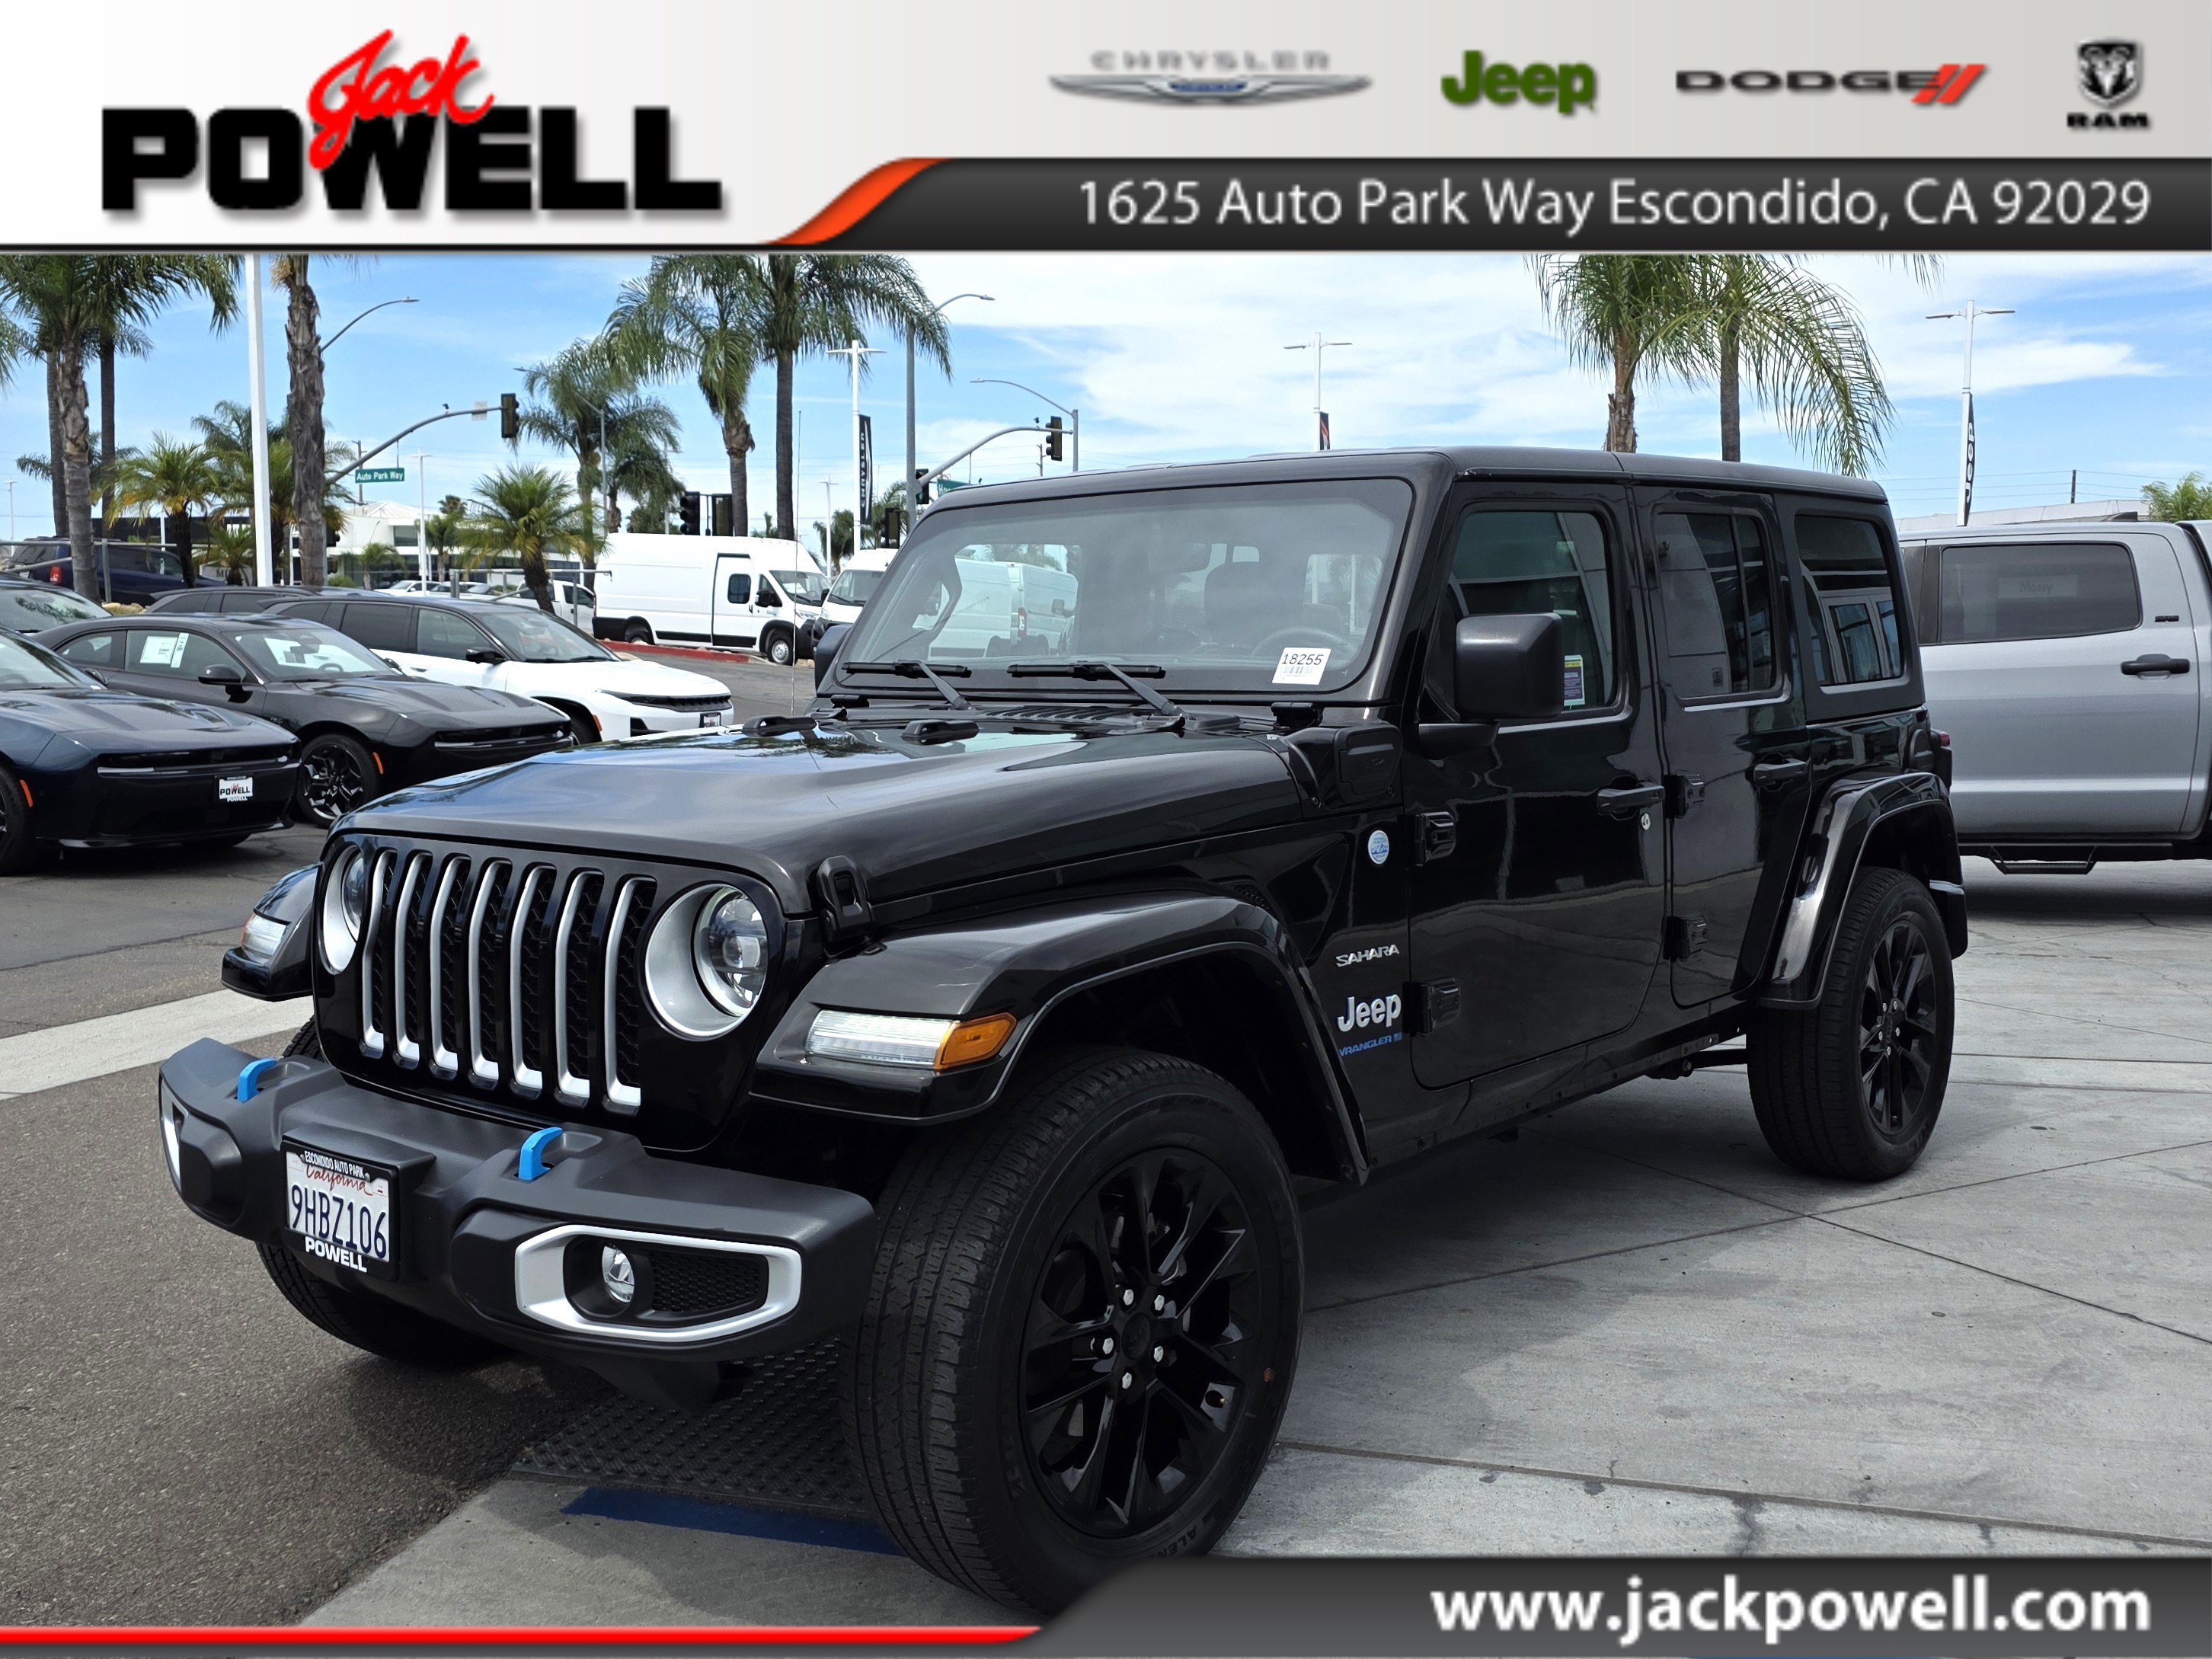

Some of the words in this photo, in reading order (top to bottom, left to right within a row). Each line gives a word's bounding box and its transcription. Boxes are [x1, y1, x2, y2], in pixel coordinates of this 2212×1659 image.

[373, 471, 388, 480] Park
[390, 471, 404, 480] Way
[1964, 422, 1974, 503] Jeep
[1282, 654, 1324, 666] 18255
[220, 786, 250, 795] POWELL
[1335, 944, 1399, 967] SAHARA
[1337, 994, 1402, 1032] Jeep
[305, 1150, 334, 1171] ESCONDIDO
[334, 1159, 349, 1175] AUTO
[348, 1163, 366, 1179] PARK
[306, 1165, 372, 1196] California
[291, 1184, 387, 1259] 9HBZ106
[305, 1235, 368, 1273] POWELL
